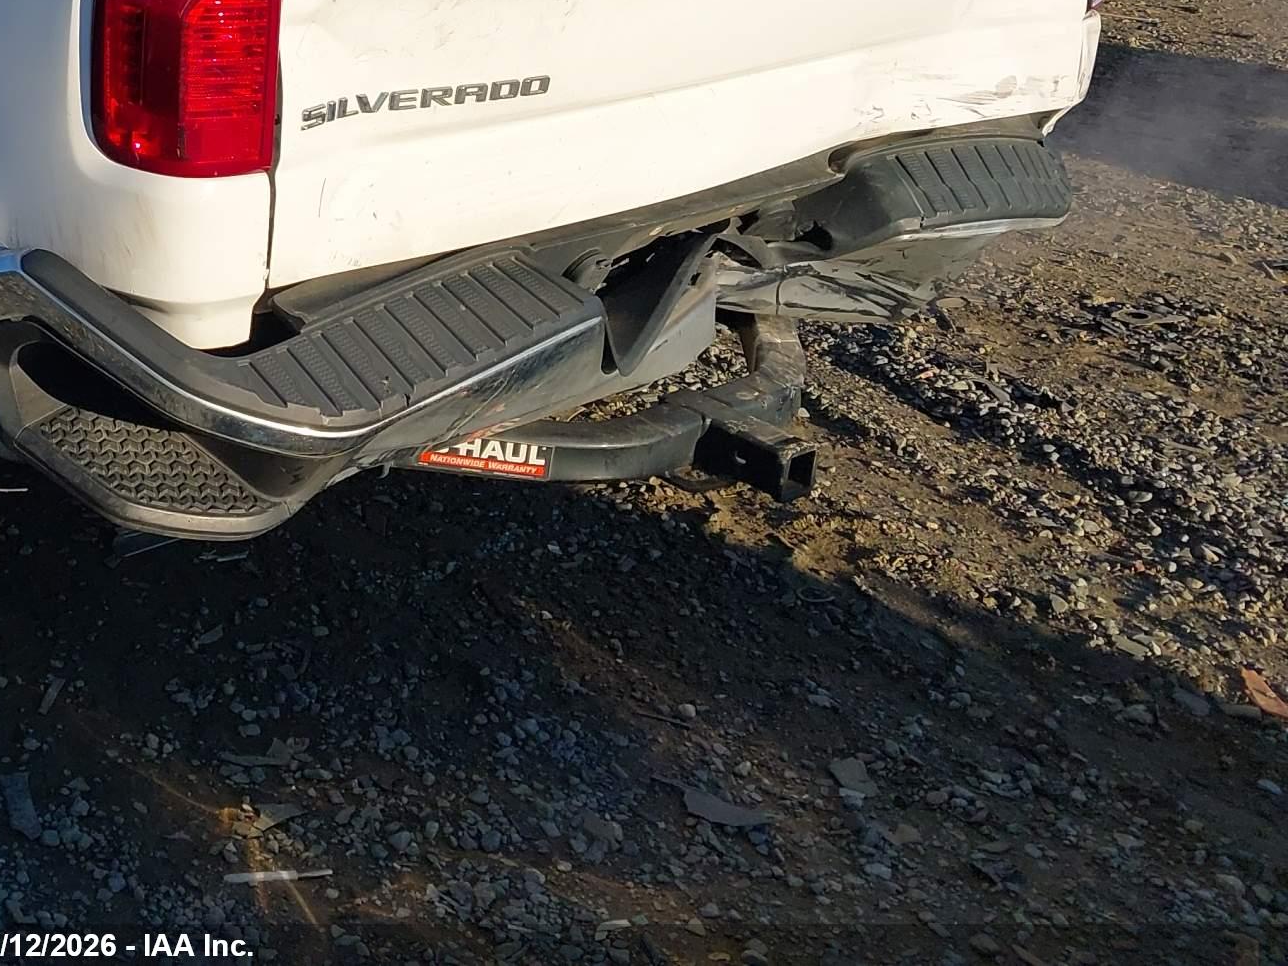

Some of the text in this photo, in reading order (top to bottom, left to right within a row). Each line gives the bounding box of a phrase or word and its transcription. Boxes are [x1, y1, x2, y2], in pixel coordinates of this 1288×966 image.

[300, 74, 551, 131] SILVERADO
[429, 453, 538, 475] NATIONWIDE WARRANTY
